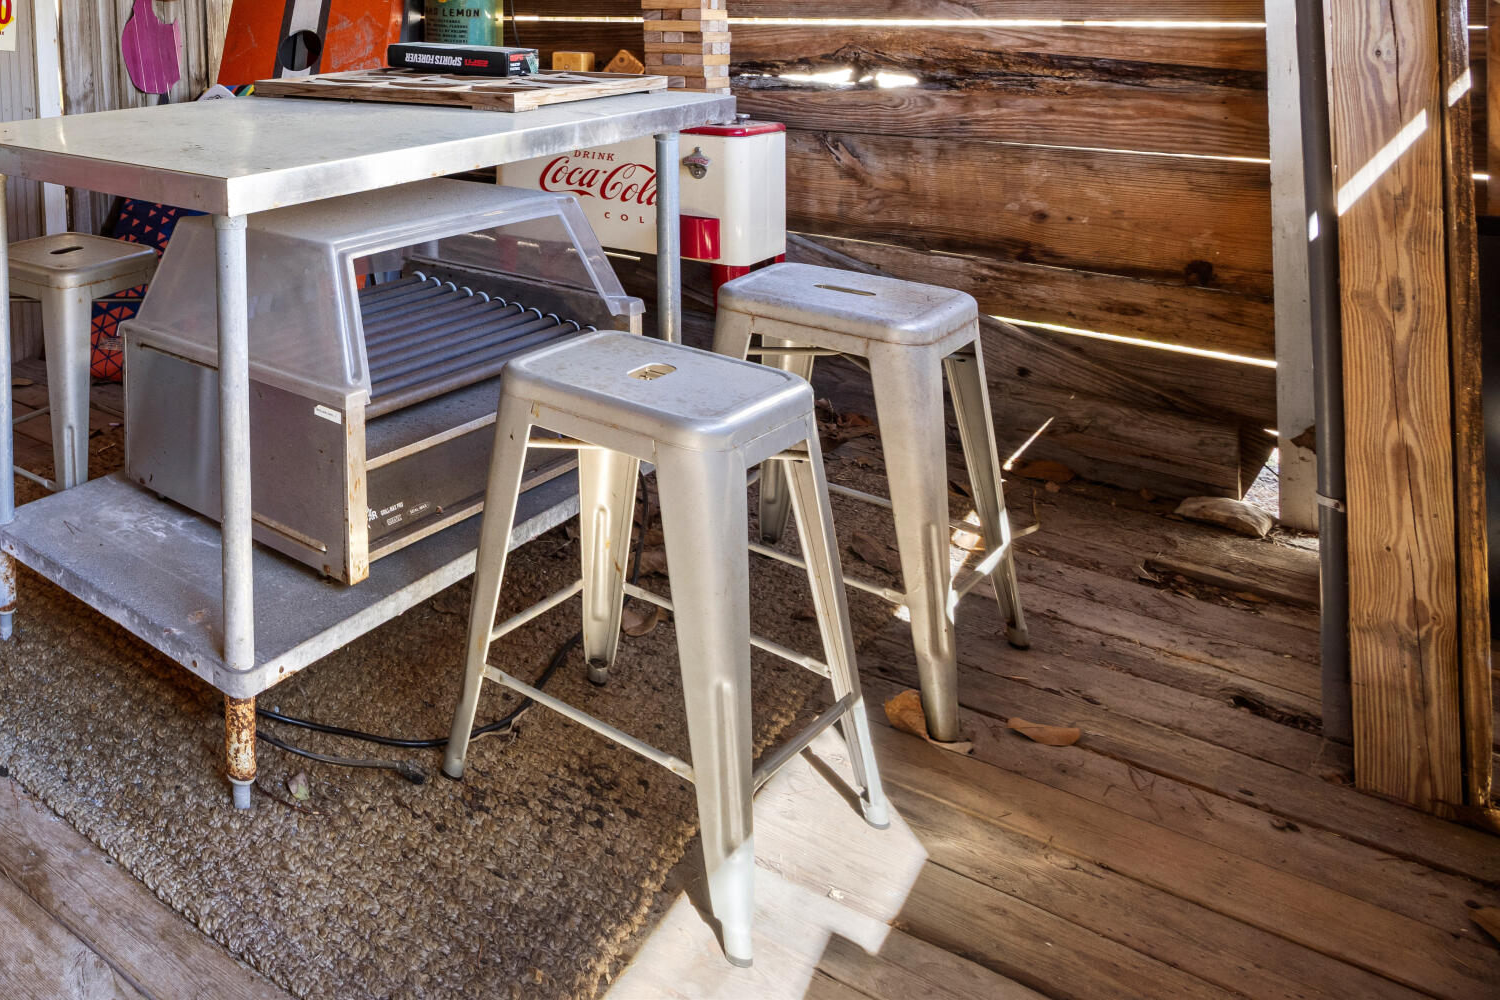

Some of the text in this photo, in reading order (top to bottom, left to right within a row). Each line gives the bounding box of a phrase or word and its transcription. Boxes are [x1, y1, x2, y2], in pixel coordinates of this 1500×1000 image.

[442, 8, 480, 17] LEMON
[404, 52, 435, 65] FOREVER
[435, 56, 462, 67] SPORTS
[574, 149, 615, 162] DRINK
